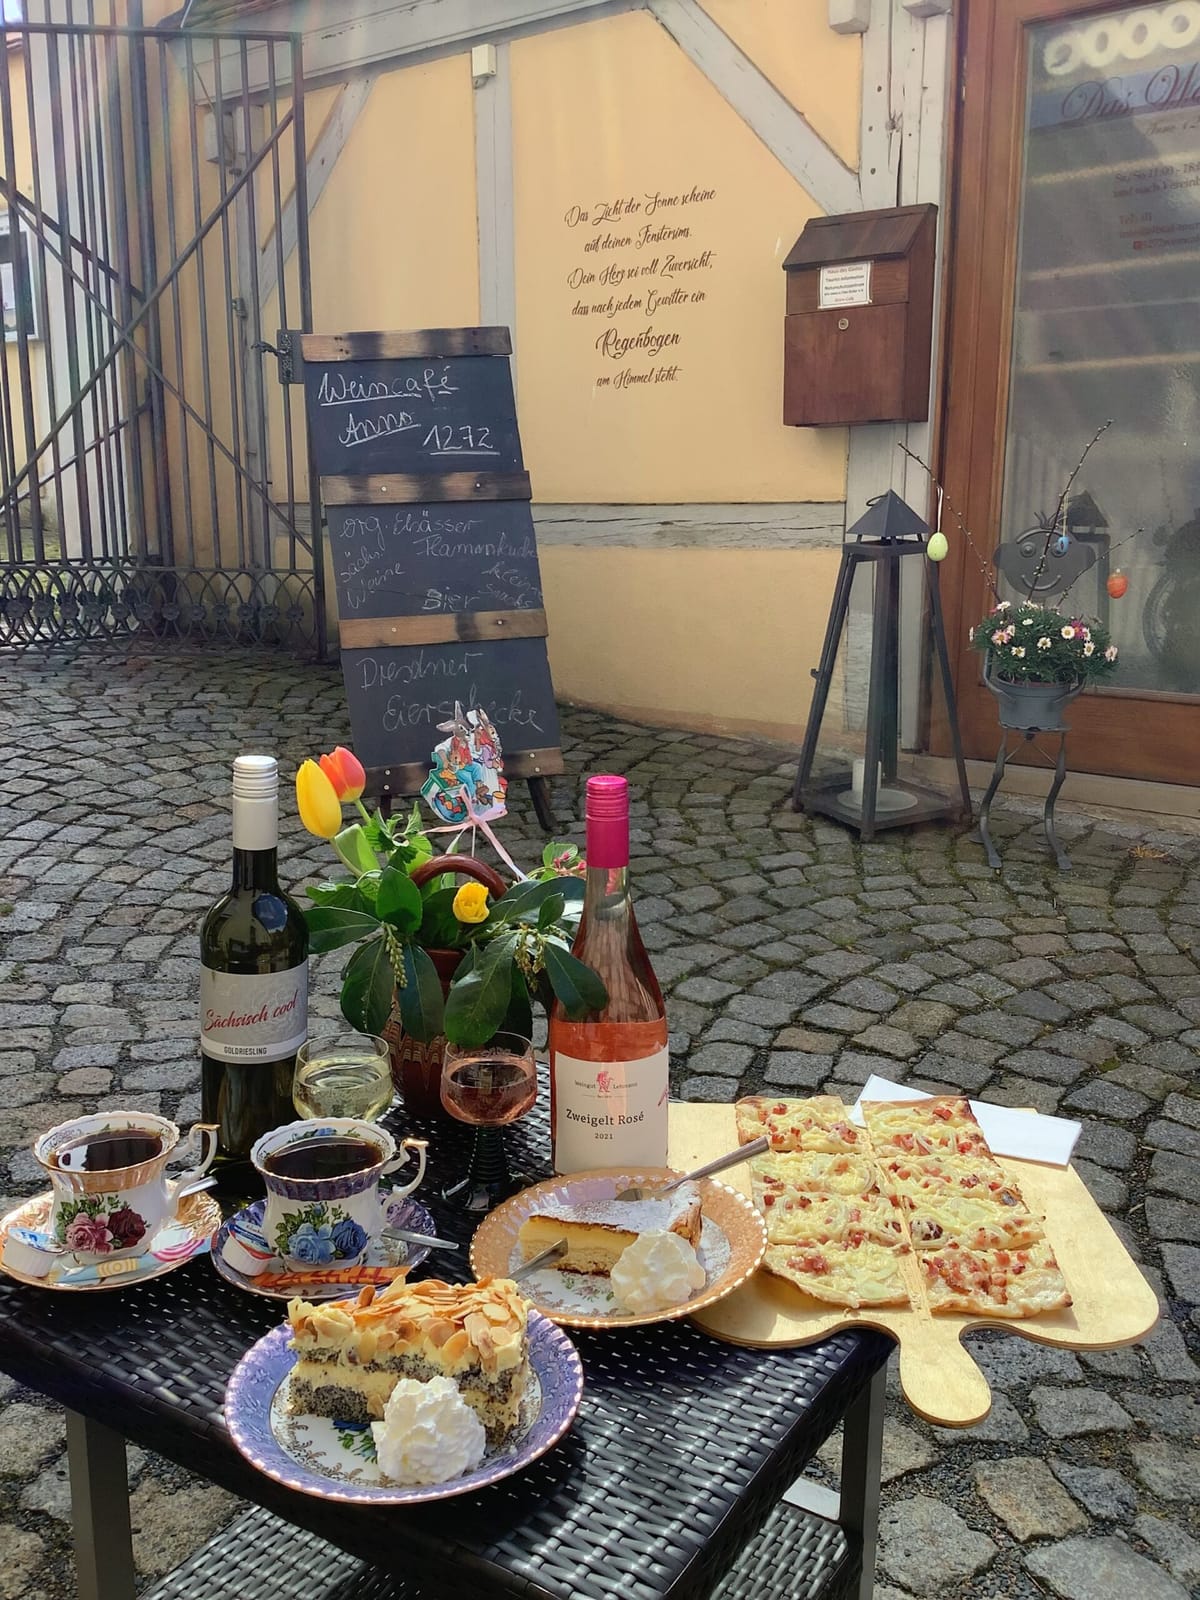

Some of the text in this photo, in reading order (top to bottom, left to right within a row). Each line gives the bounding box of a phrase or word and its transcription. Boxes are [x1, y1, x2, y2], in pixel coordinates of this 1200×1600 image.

[565, 185, 716, 227] Das Licht der Sonne scheine
[584, 234, 600, 253] auf
[601, 233, 632, 250] deinen
[567, 251, 717, 289] Dein Herz sei voll Zuversicht,
[572, 288, 706, 318] dass nach jedem Gewitter ein
[595, 326, 681, 359] Regenbogen
[318, 366, 459, 402] Weincafé
[596, 375, 610, 388] am
[613, 367, 654, 389] Himmel
[338, 411, 494, 452] Anno 1272
[421, 586, 482, 612] Bier
[356, 649, 483, 690] Dresdner
[204, 988, 299, 1032] Sächsisch cool
[223, 1046, 268, 1056] GOLDRIESLING
[566, 1108, 645, 1127] Zweigelt Rosé
[595, 1132, 614, 1140] 2021
